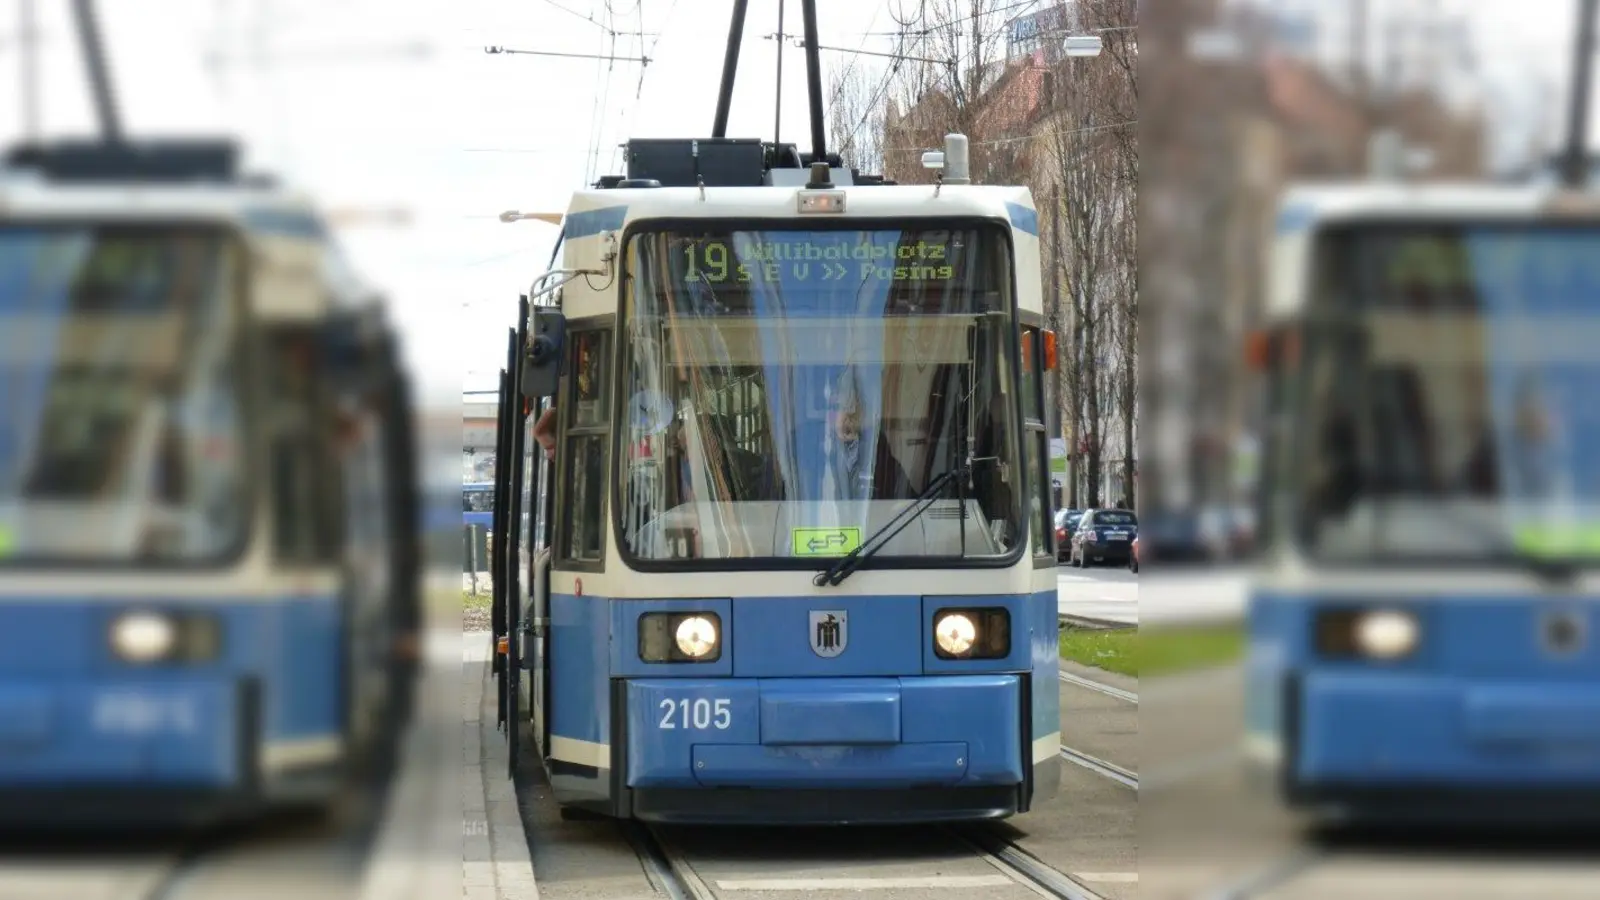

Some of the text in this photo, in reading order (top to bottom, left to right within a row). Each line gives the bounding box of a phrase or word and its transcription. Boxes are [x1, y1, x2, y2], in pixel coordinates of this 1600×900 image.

[684, 243, 728, 281] 19
[744, 242, 946, 260] Willibaldplatz
[860, 261, 953, 280] Pasing
[659, 698, 732, 729] 2105
